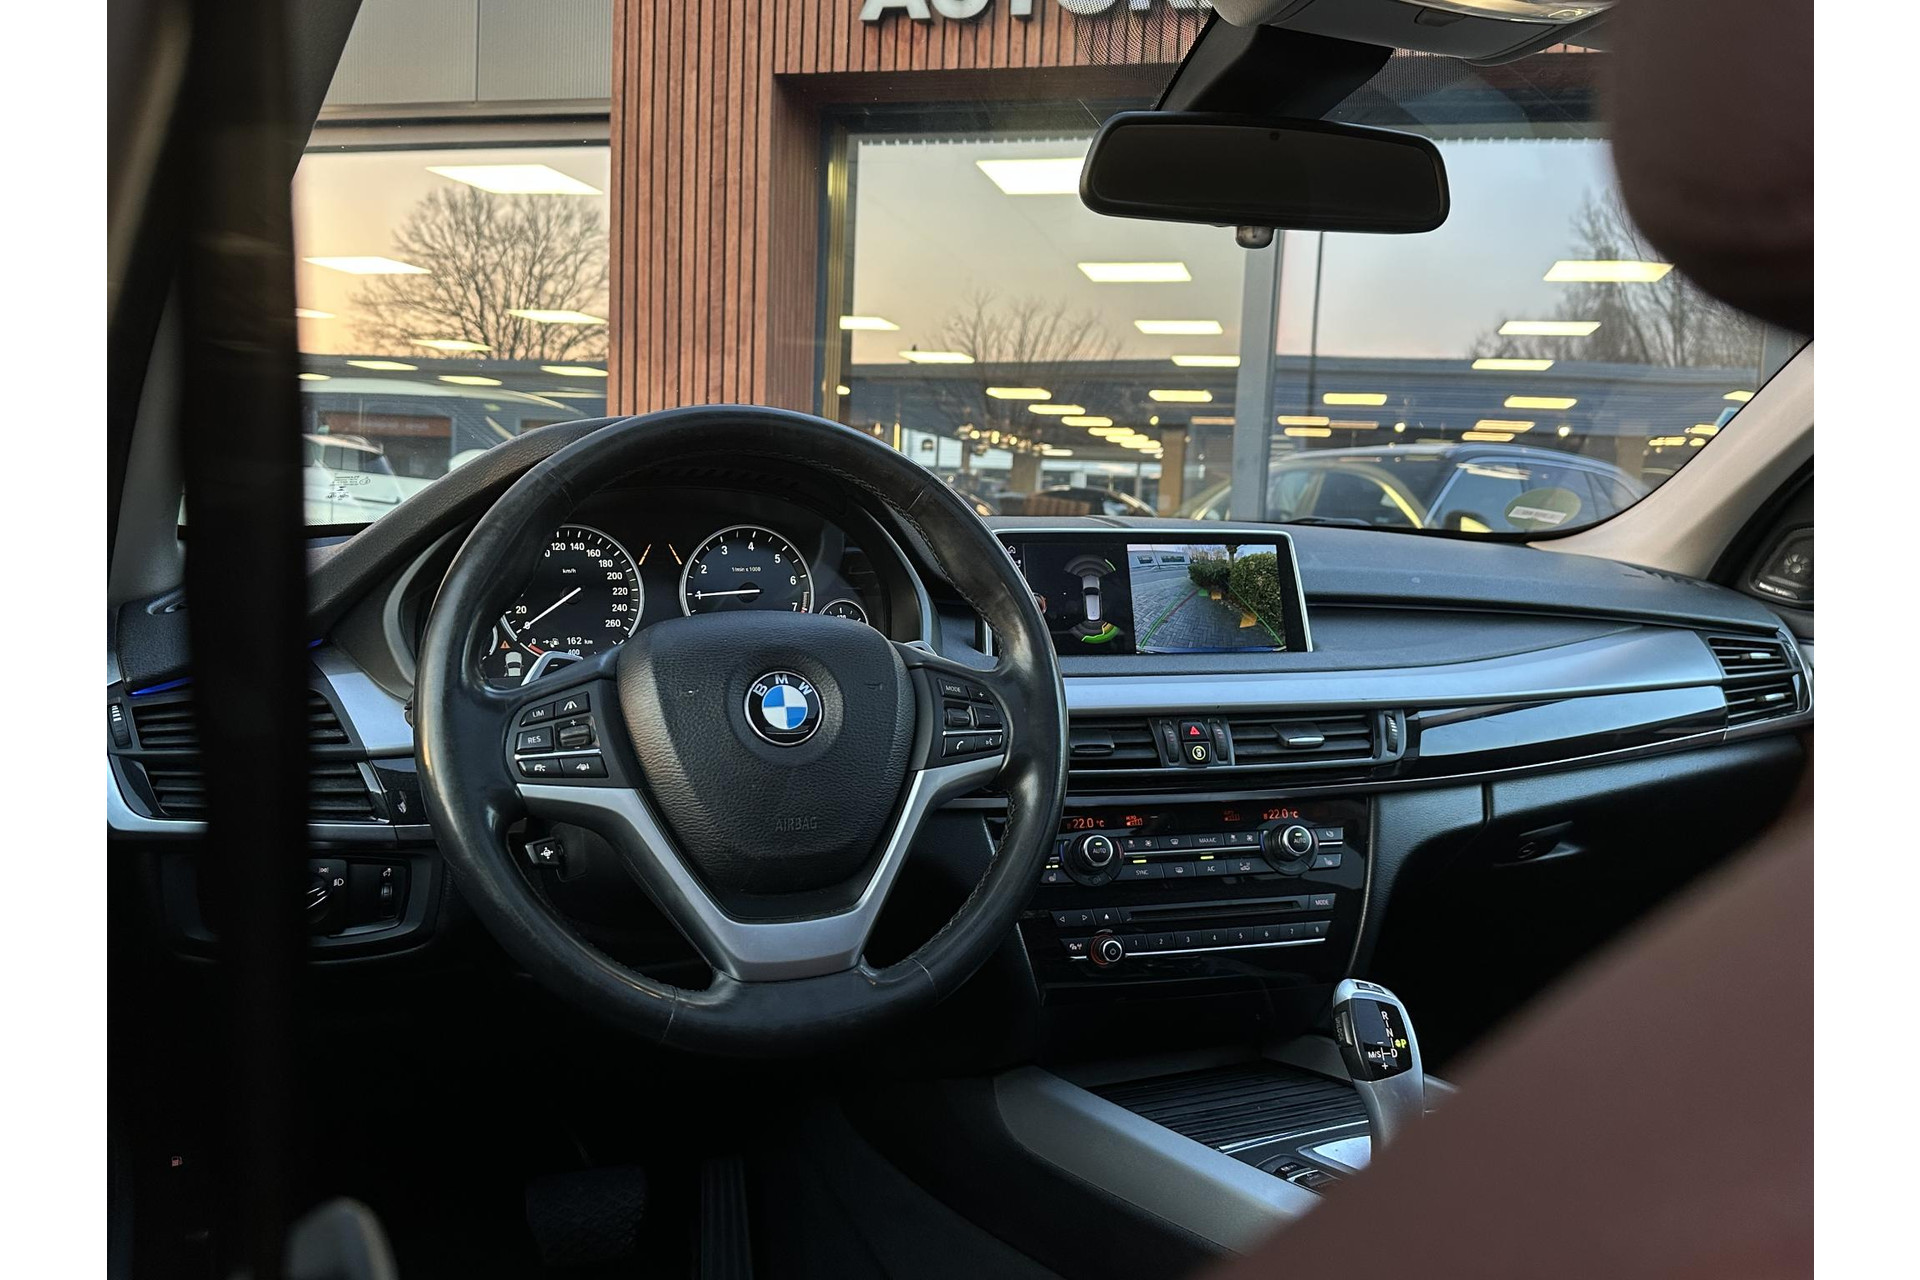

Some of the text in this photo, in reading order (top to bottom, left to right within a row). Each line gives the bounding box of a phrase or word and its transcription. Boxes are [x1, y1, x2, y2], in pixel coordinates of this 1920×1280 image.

[551, 542, 566, 551] 120
[570, 542, 585, 551] 140
[721, 545, 728, 555] 3
[748, 542, 754, 551] 4
[586, 549, 601, 557] 160
[774, 554, 781, 564] 5
[599, 560, 613, 568] 180
[701, 565, 708, 574] 2
[790, 575, 797, 585] 6
[612, 587, 628, 596] 220
[515, 606, 527, 614] 20
[612, 604, 628, 612] 240
[791, 602, 798, 612] 7
[605, 619, 621, 628] 260
[566, 637, 582, 645] 162
[752, 673, 813, 697] BMW
[532, 709, 545, 718] LIM
[527, 735, 542, 744] RES
[774, 816, 818, 832] AIRBAG
[1381, 1011, 1389, 1020] R
[1385, 1027, 1394, 1037] N
[1400, 1039, 1407, 1048] P
[1390, 1048, 1398, 1058] D
